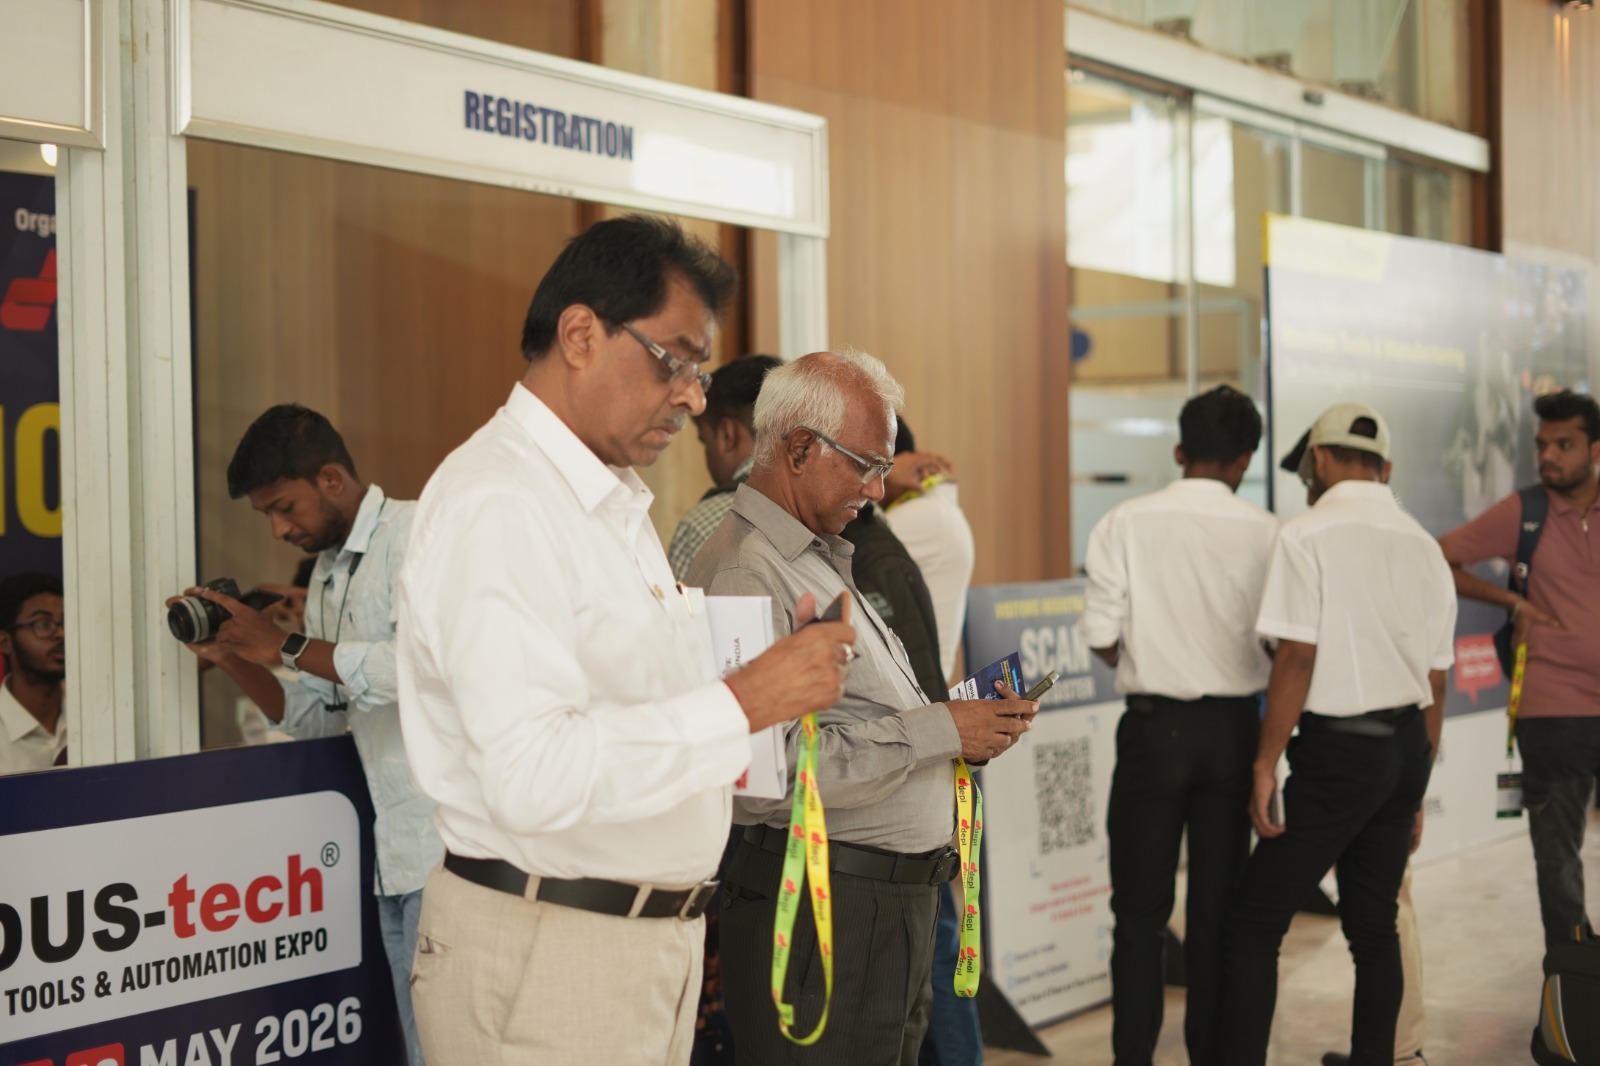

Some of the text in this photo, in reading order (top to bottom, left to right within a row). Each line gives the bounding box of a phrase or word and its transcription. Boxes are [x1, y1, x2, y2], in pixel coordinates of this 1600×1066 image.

[465, 91, 634, 160] REGISTRATION
[15, 207, 56, 238] Orga
[1021, 626, 1091, 680] SCAN
[958, 785, 967, 803] depl
[967, 871, 975, 889] depl
[966, 913, 975, 931] depl
[5, 927, 328, 1016] TOOLS & AUTOMATION EXPO
[139, 996, 362, 1066] MAY 2026
